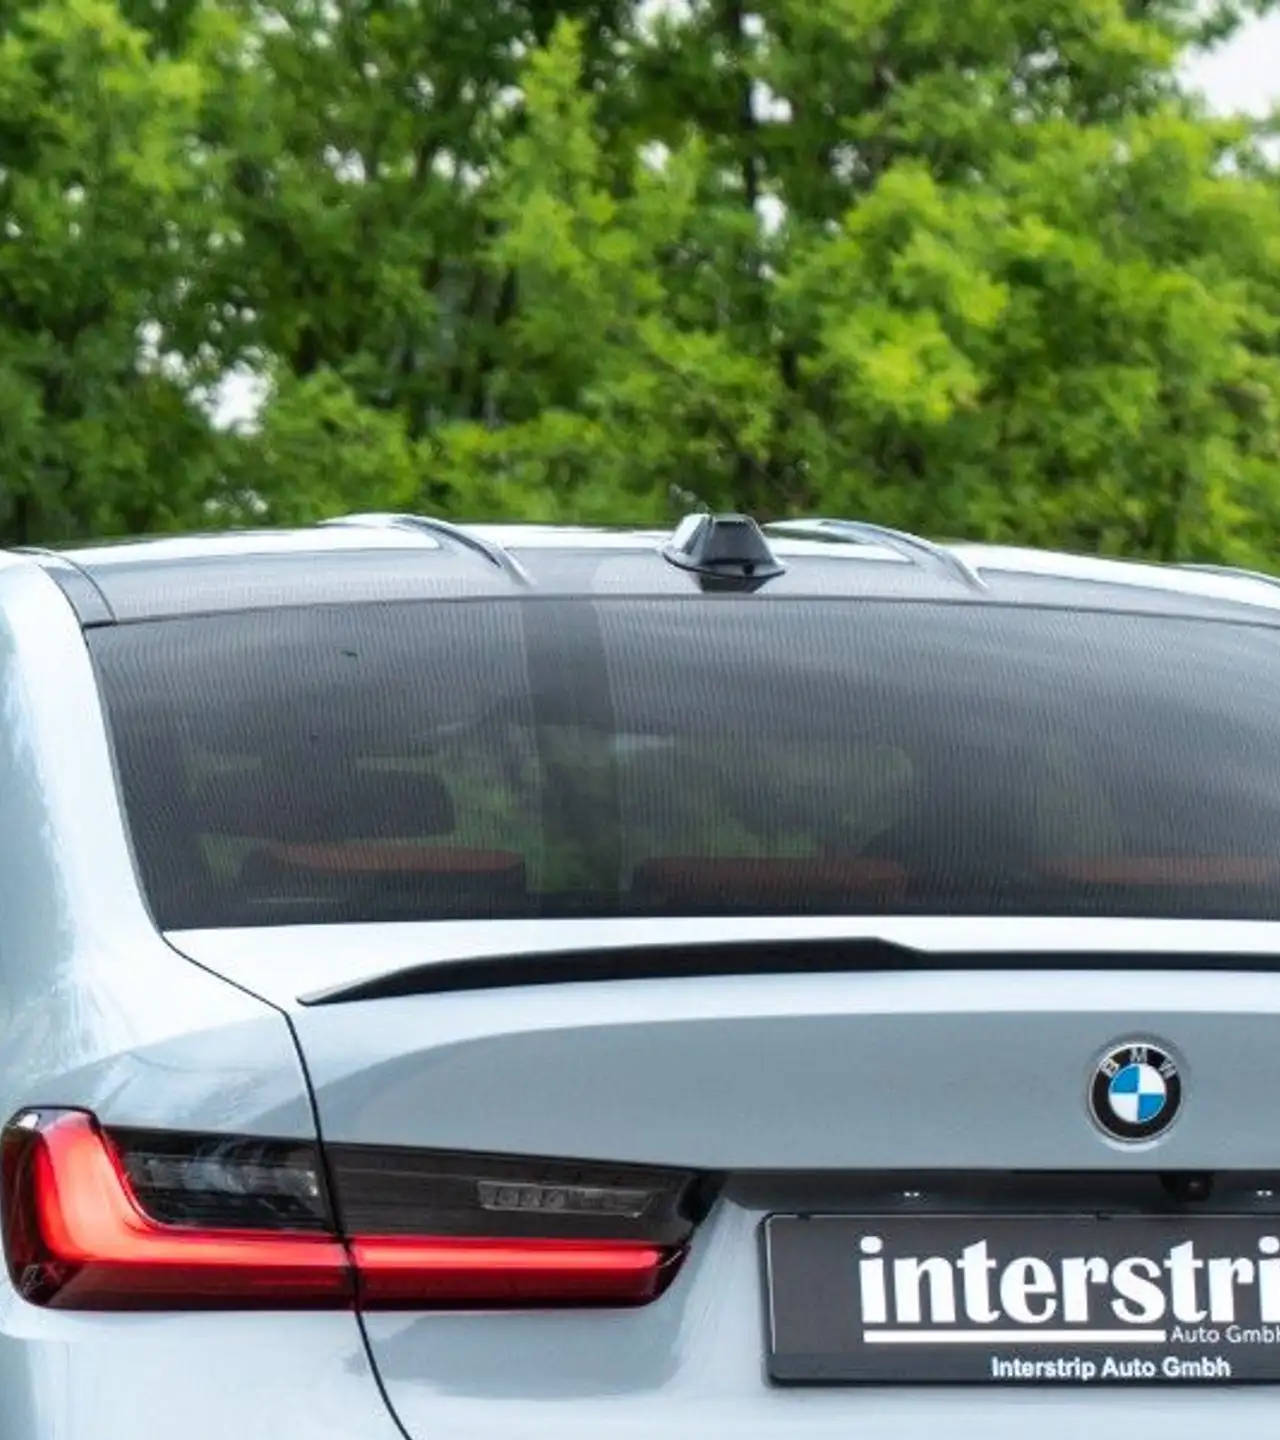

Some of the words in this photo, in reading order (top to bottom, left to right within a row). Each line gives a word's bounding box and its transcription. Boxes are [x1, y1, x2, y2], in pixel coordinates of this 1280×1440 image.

[1099, 1045, 1177, 1080] BMW
[1170, 1326, 1219, 1343] Auto
[992, 1355, 1096, 1382] Interstrip
[1102, 1356, 1156, 1379] Auto
[1162, 1356, 1232, 1378] Gmbh
